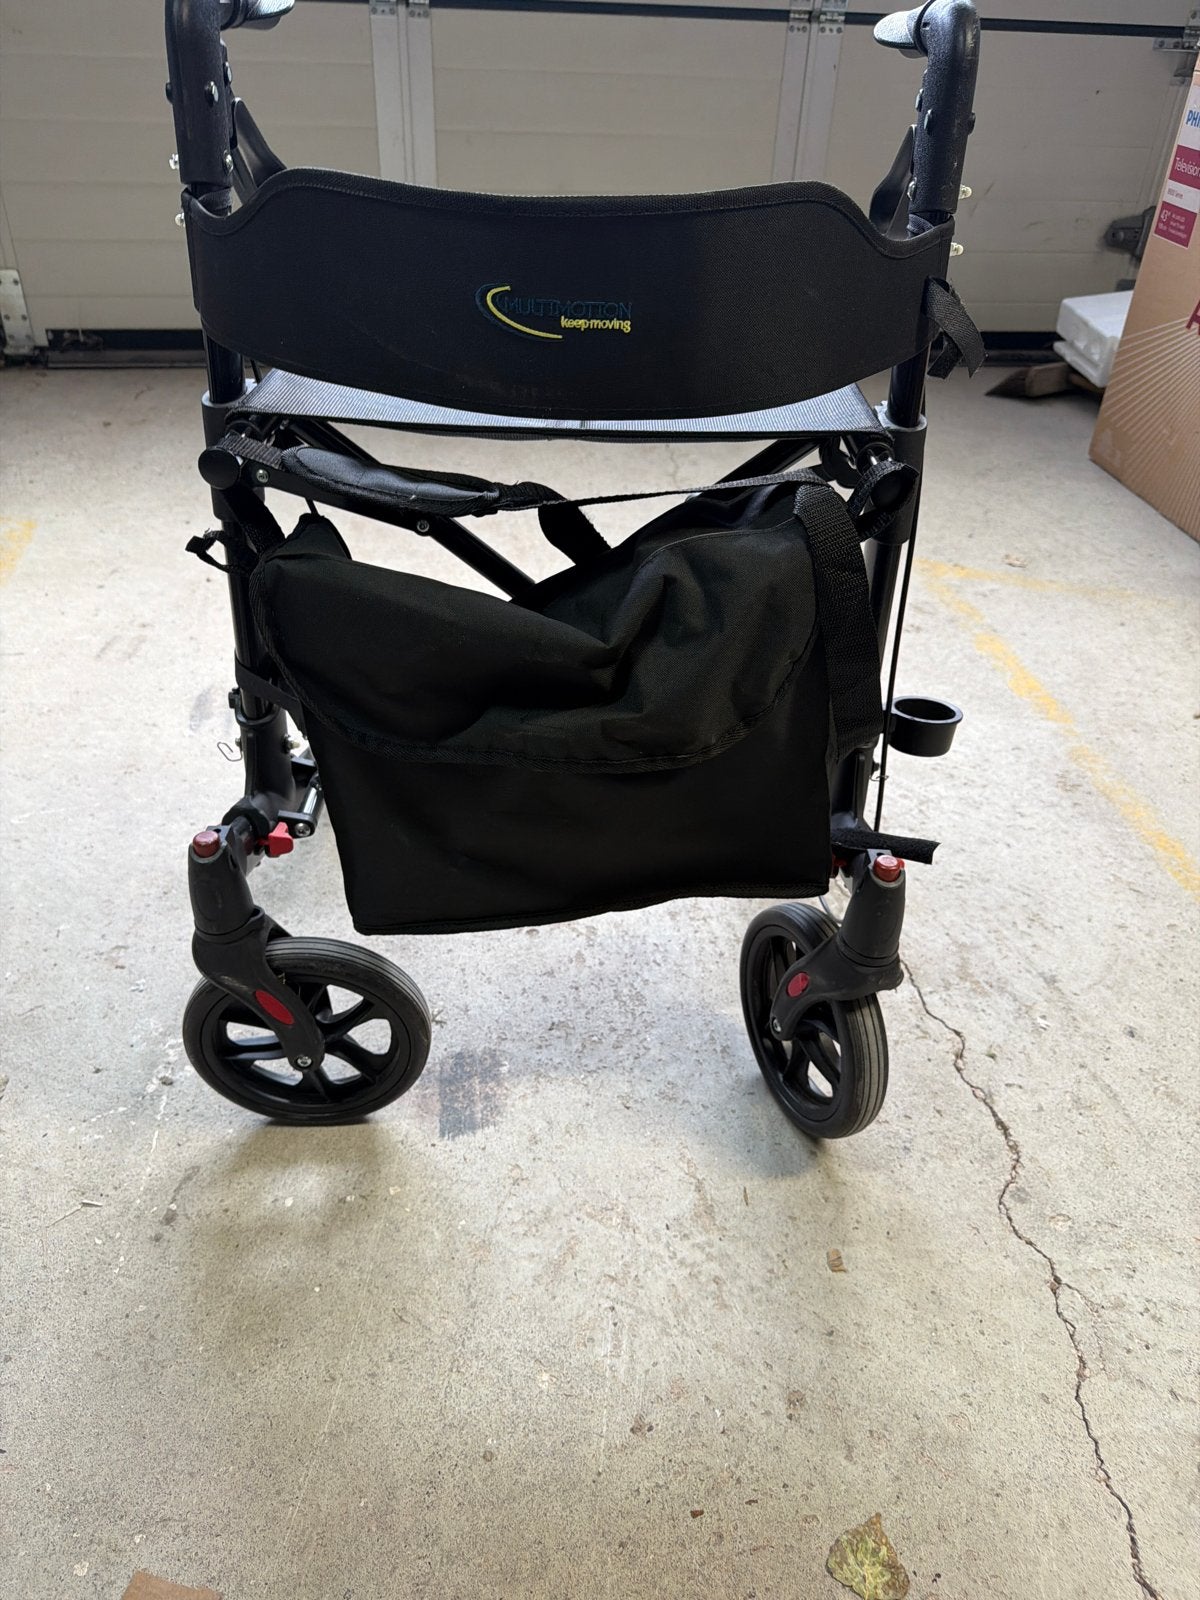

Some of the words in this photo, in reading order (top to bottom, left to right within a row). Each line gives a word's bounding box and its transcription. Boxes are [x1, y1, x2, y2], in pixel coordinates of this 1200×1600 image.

[503, 295, 632, 319] MULTIMOTION
[560, 315, 590, 331] keep
[590, 317, 632, 333] moving
